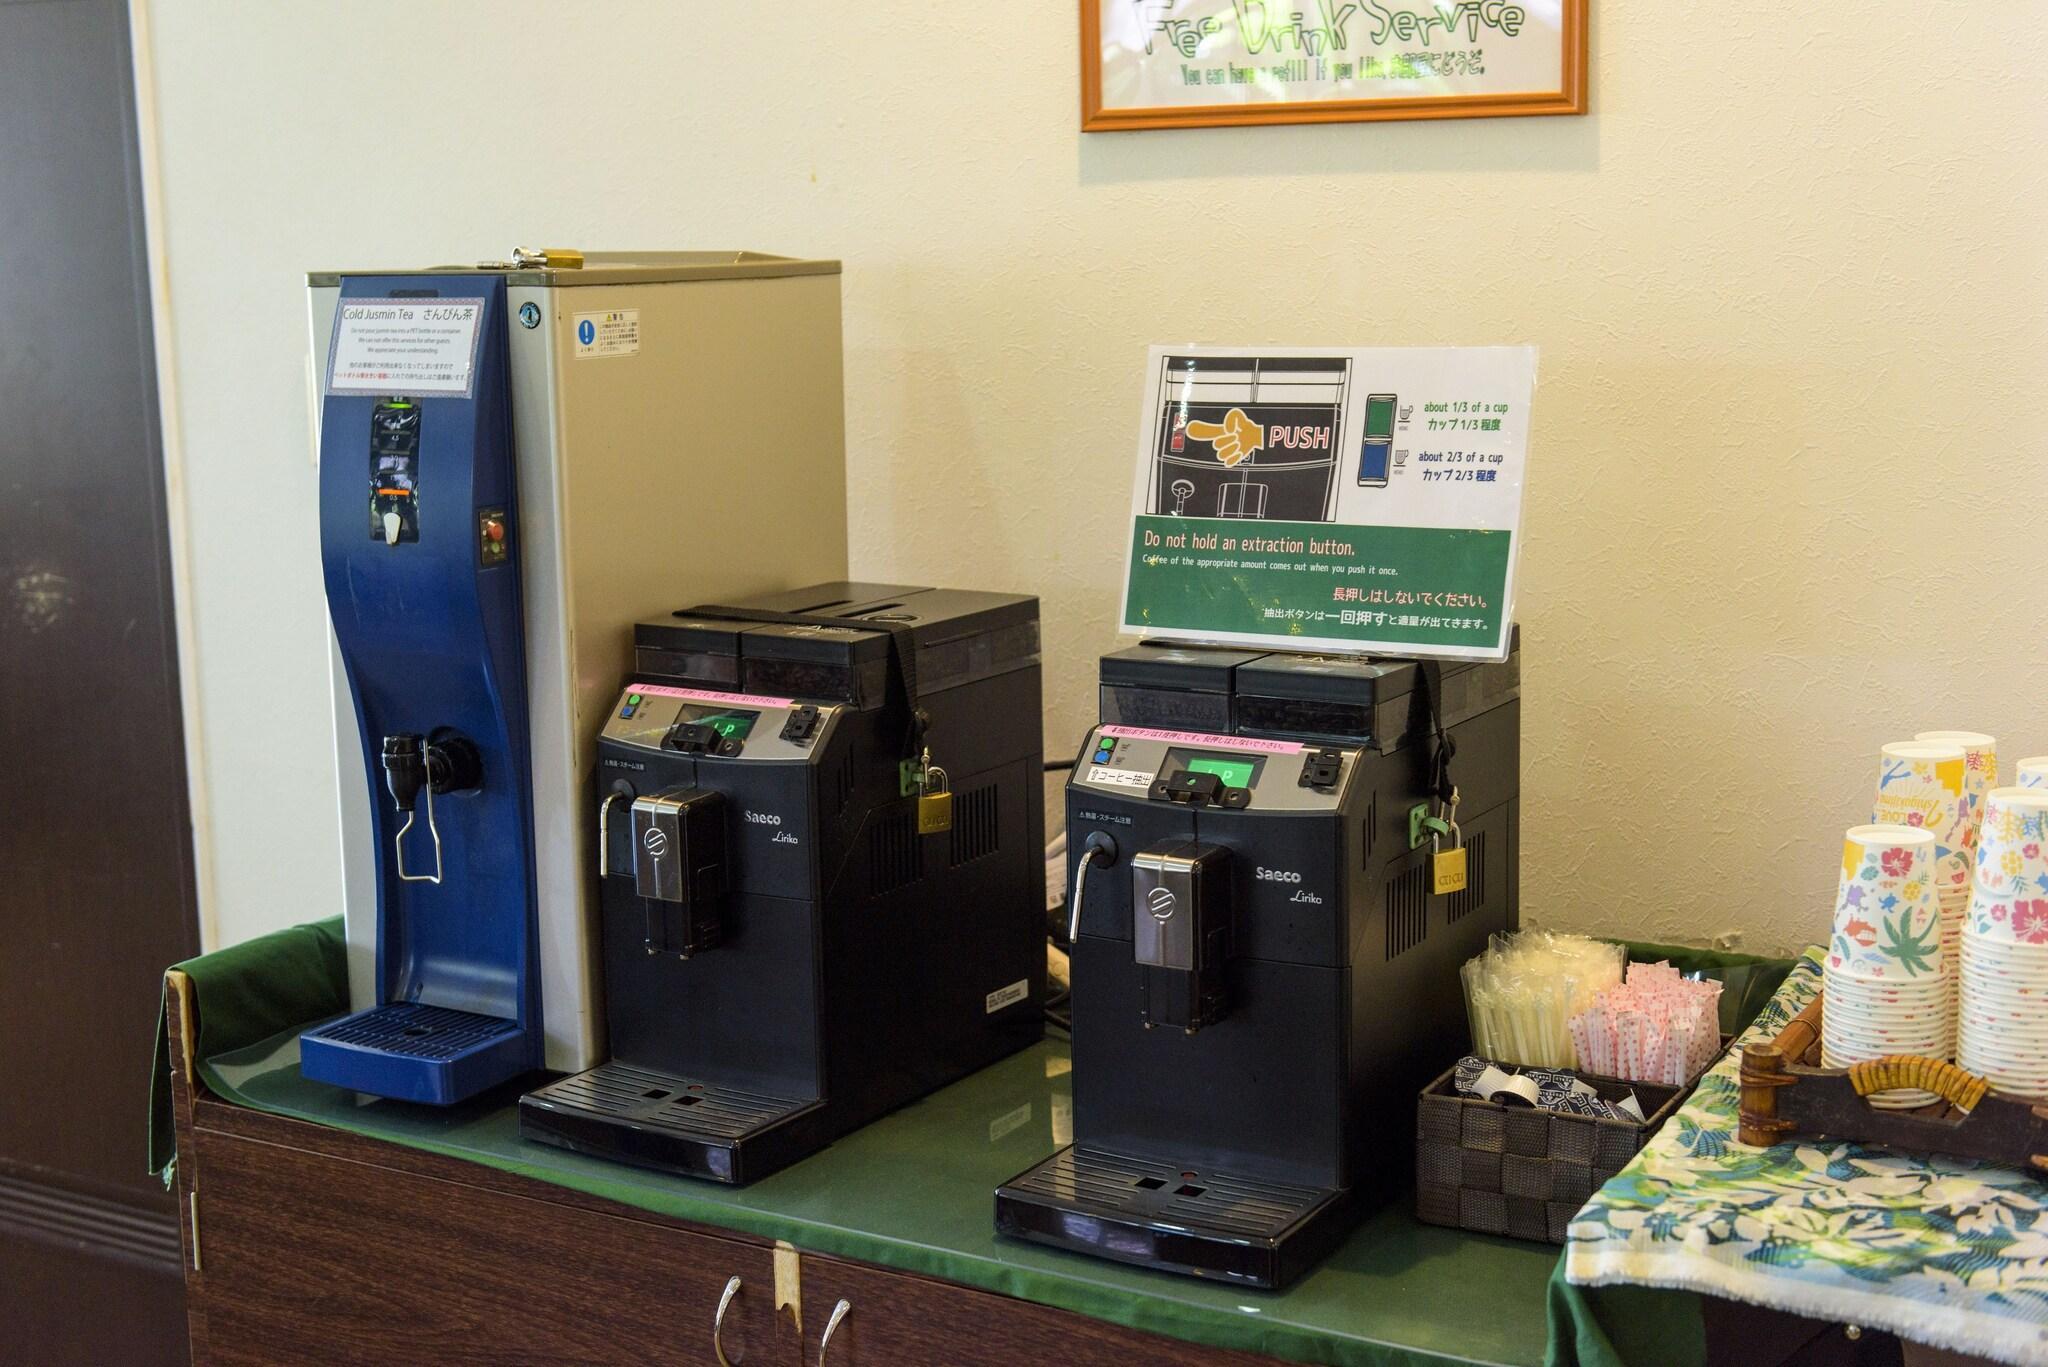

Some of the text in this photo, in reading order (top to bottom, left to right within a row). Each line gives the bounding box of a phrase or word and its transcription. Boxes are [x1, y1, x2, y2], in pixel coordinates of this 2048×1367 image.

[343, 308, 414, 320] Cold Jusmin Tea
[1424, 402, 1508, 414] about 1/3 of a cup
[1268, 425, 1330, 449] PUSH
[1418, 452, 1503, 465] about 2/3 of a cup
[1144, 530, 1355, 556] Do not hold an extraction button.
[1142, 554, 1399, 576] Coffee of the appropriate amount comes out when you push it once.
[1333, 587, 1488, 608] 長押しはしないでください。
[1264, 607, 1488, 630] 抽出ボタンは一回押すと適量が出てきます。
[744, 810, 781, 826] Saeco
[771, 831, 799, 844] Lirika
[1255, 866, 1301, 884] Saeco
[1290, 890, 1322, 904] Lirika
